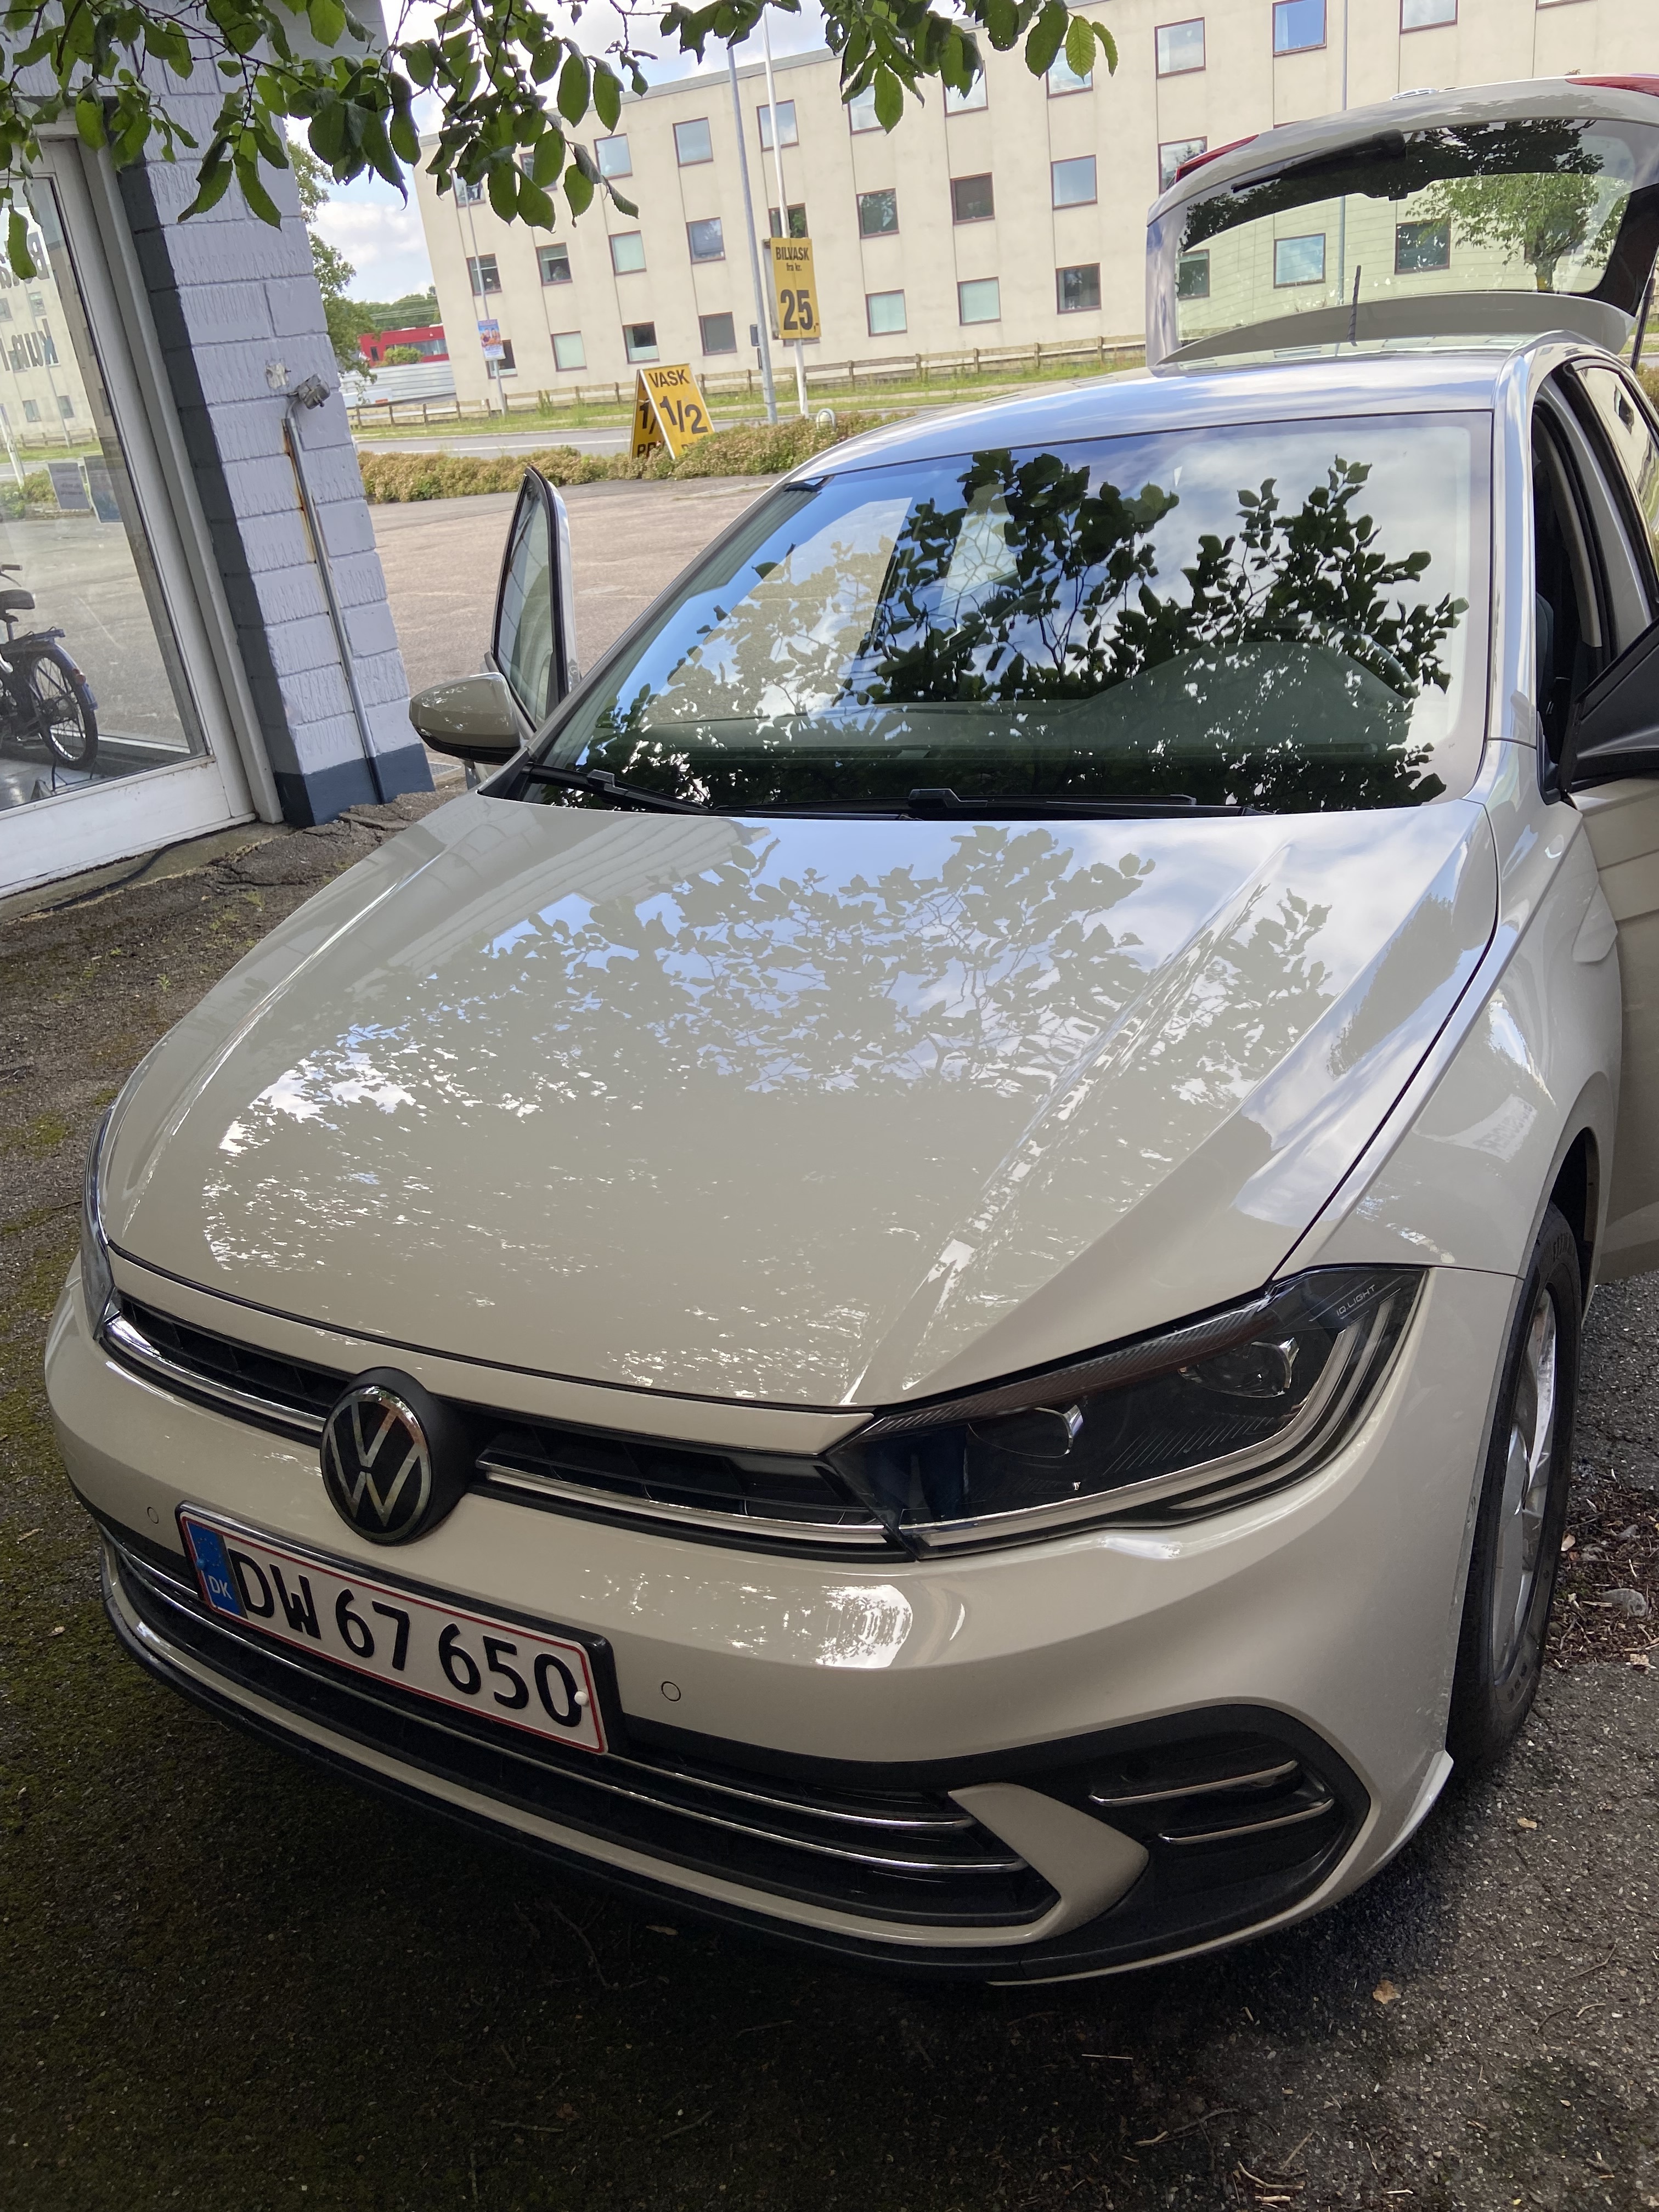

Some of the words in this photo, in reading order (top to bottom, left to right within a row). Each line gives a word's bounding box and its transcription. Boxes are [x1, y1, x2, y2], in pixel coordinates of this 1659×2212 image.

[776, 247, 809, 261] BILVASK
[648, 369, 690, 388] VASK
[659, 396, 708, 434] 1/2
[1336, 1284, 1375, 1316] IQ.LIGHT
[324, 1388, 430, 1539] VW
[208, 1575, 233, 1600] DK
[228, 1548, 321, 1640] DW
[335, 1588, 410, 1671] 67
[439, 1623, 583, 1728] 650
